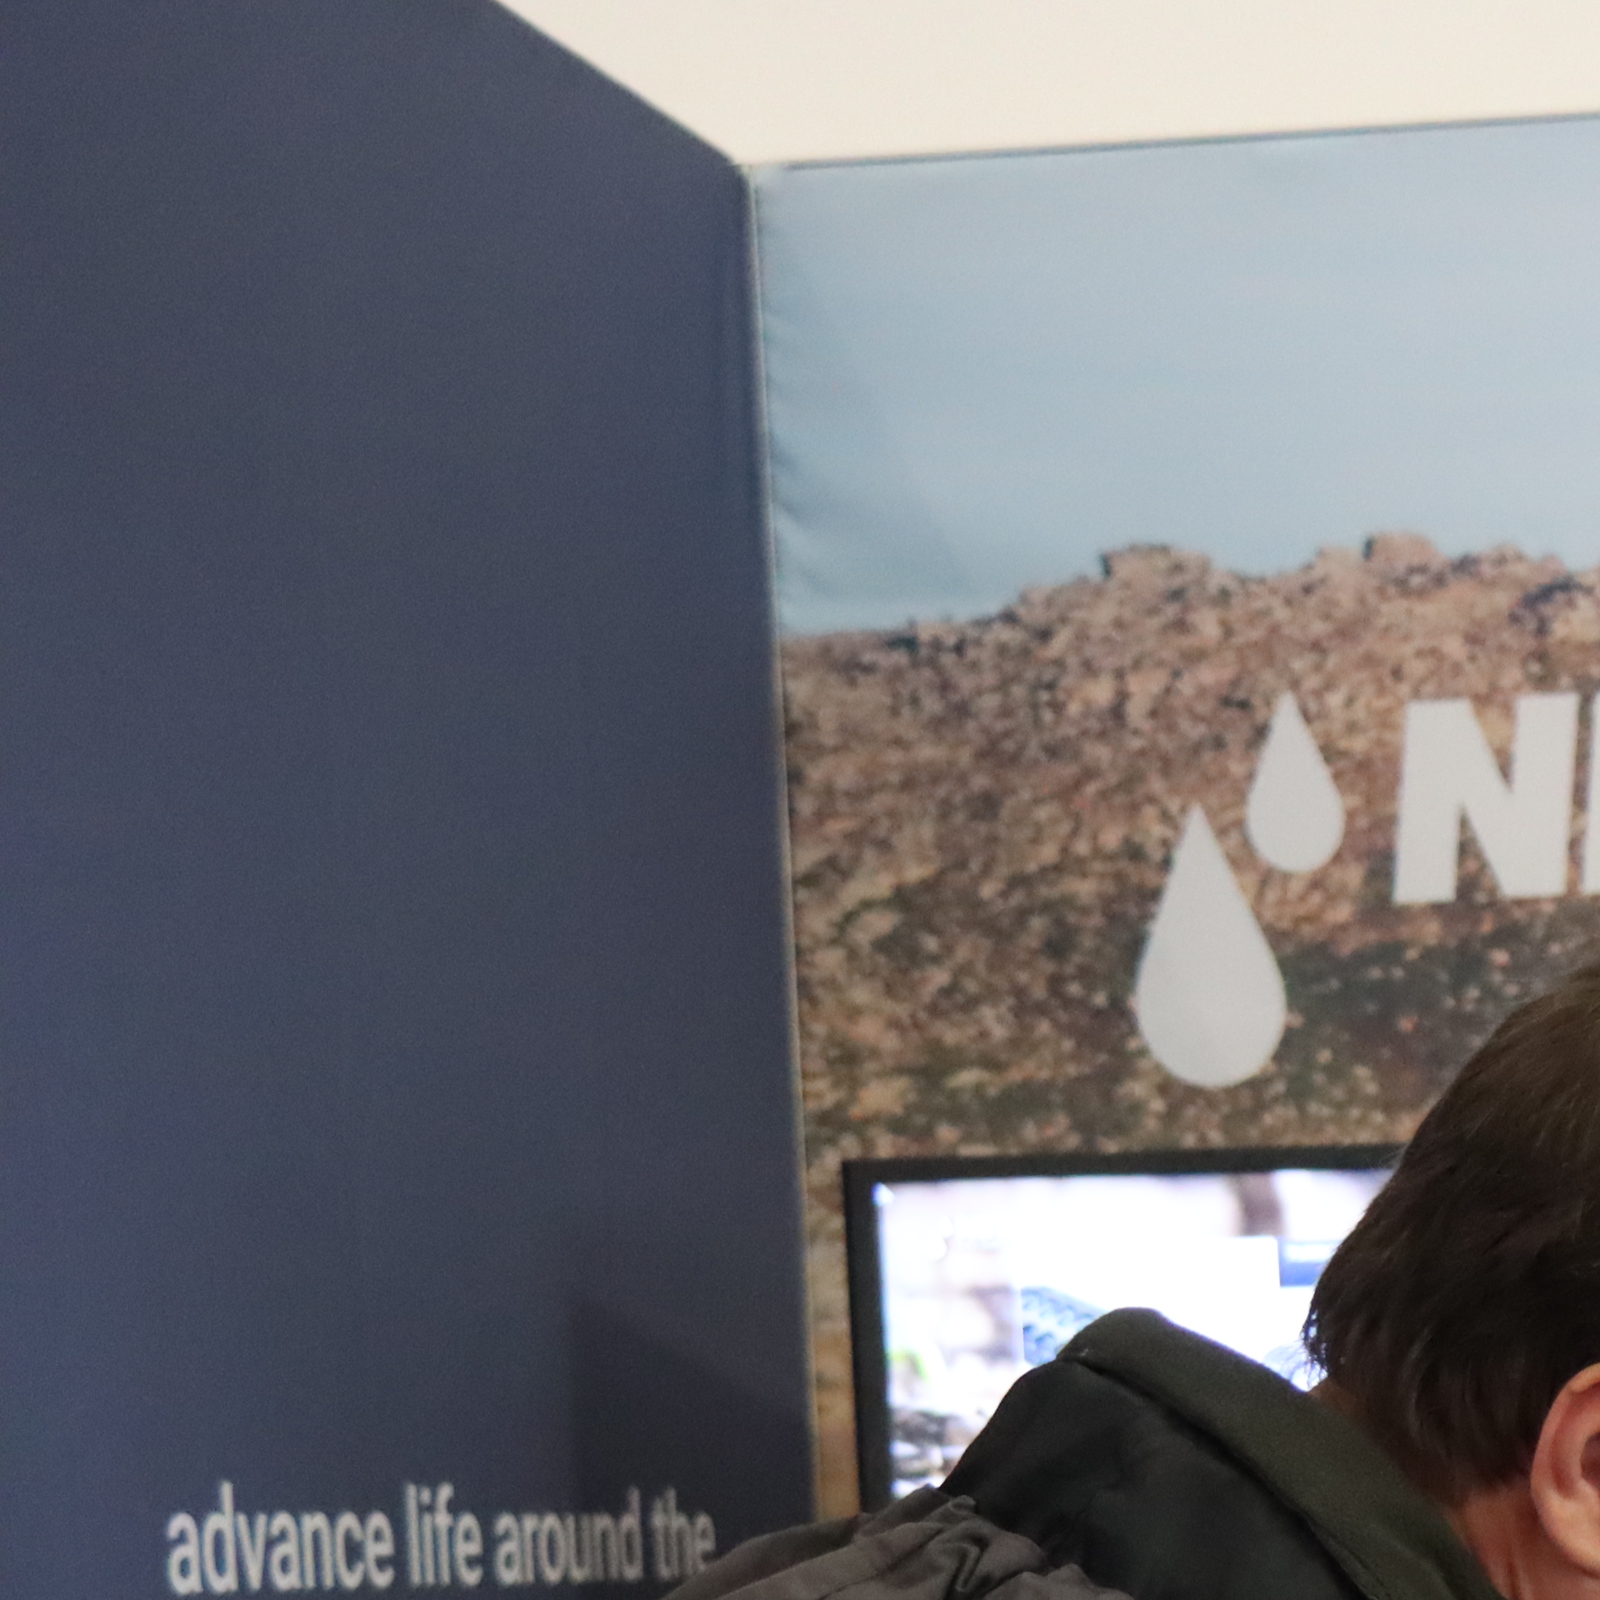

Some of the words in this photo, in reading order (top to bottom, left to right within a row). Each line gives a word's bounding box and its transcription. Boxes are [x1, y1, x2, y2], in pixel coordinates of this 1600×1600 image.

[165, 1479, 396, 1595] advance
[404, 1481, 485, 1588] life
[493, 1486, 645, 1587] around
[651, 1486, 716, 1581] the
